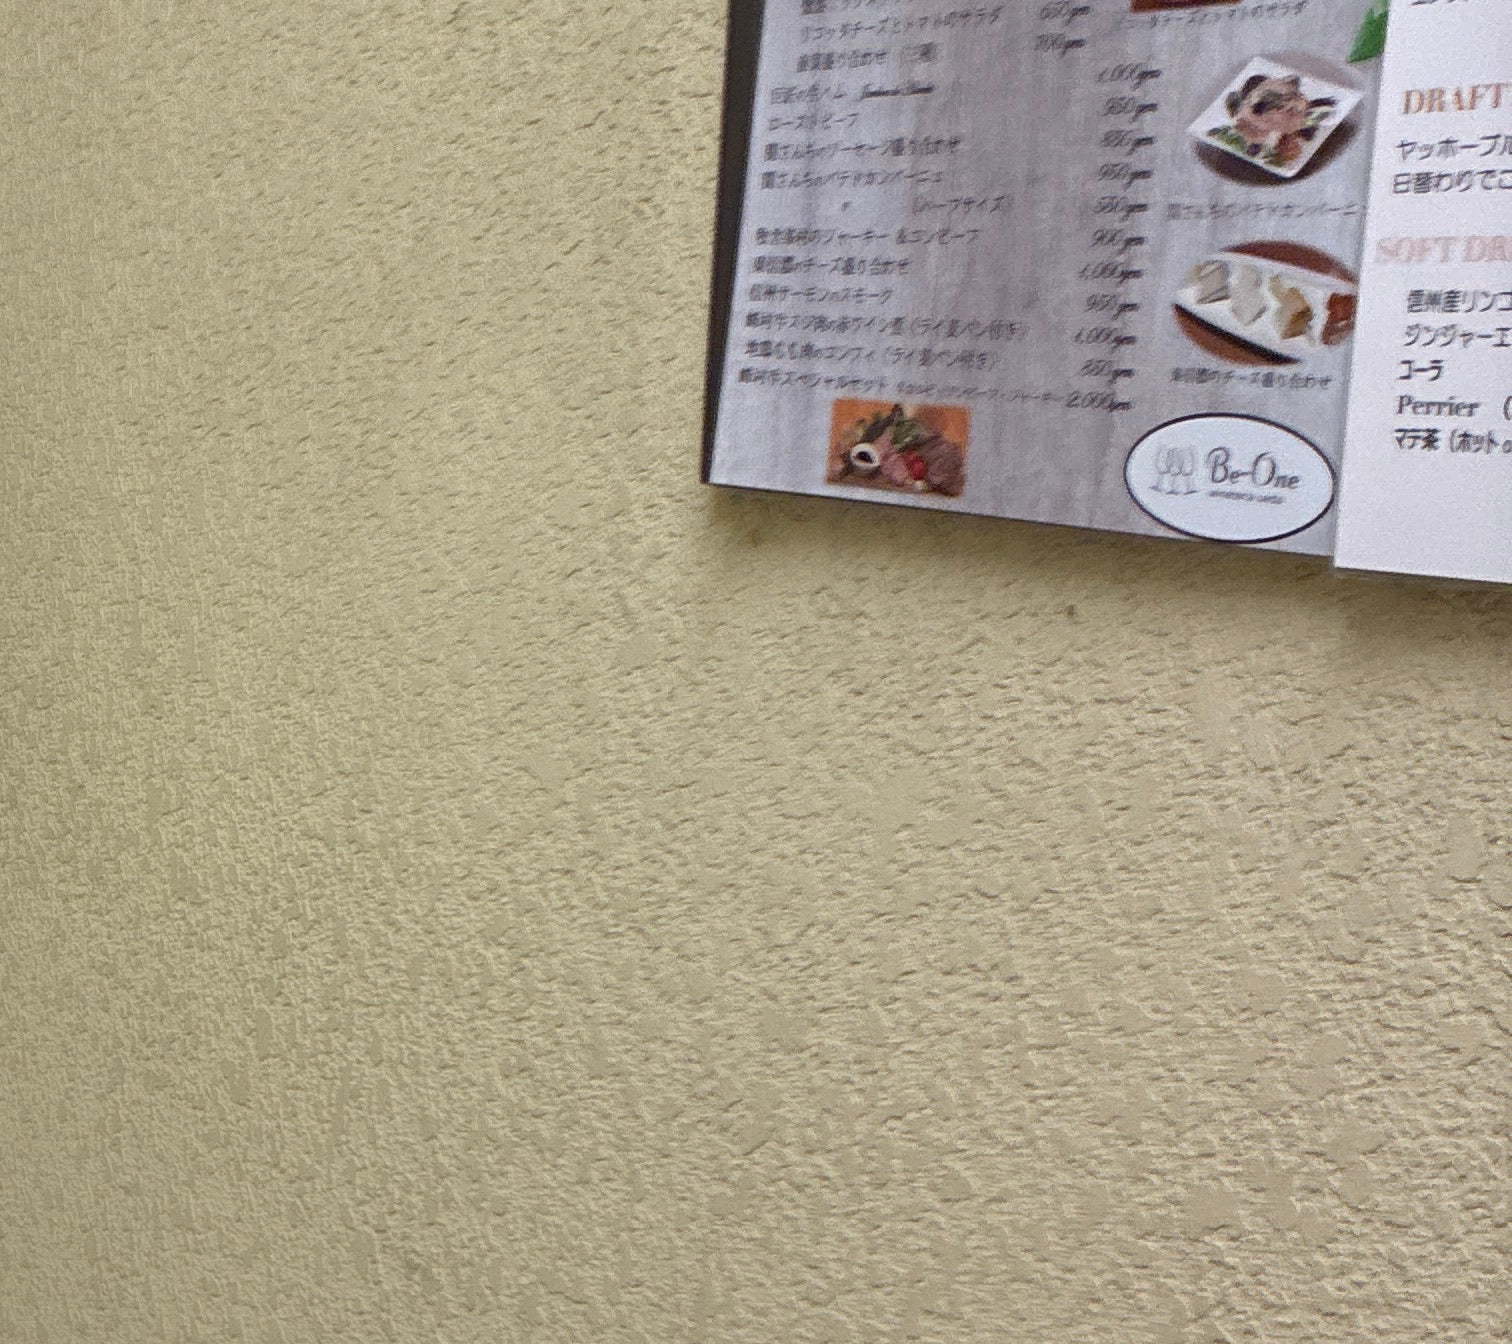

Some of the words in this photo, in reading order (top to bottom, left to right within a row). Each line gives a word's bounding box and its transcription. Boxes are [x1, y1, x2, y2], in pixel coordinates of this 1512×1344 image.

[1395, 359, 1444, 382] コーラ
[1395, 394, 1480, 417] Perrier
[1204, 445, 1301, 490] Be-One
